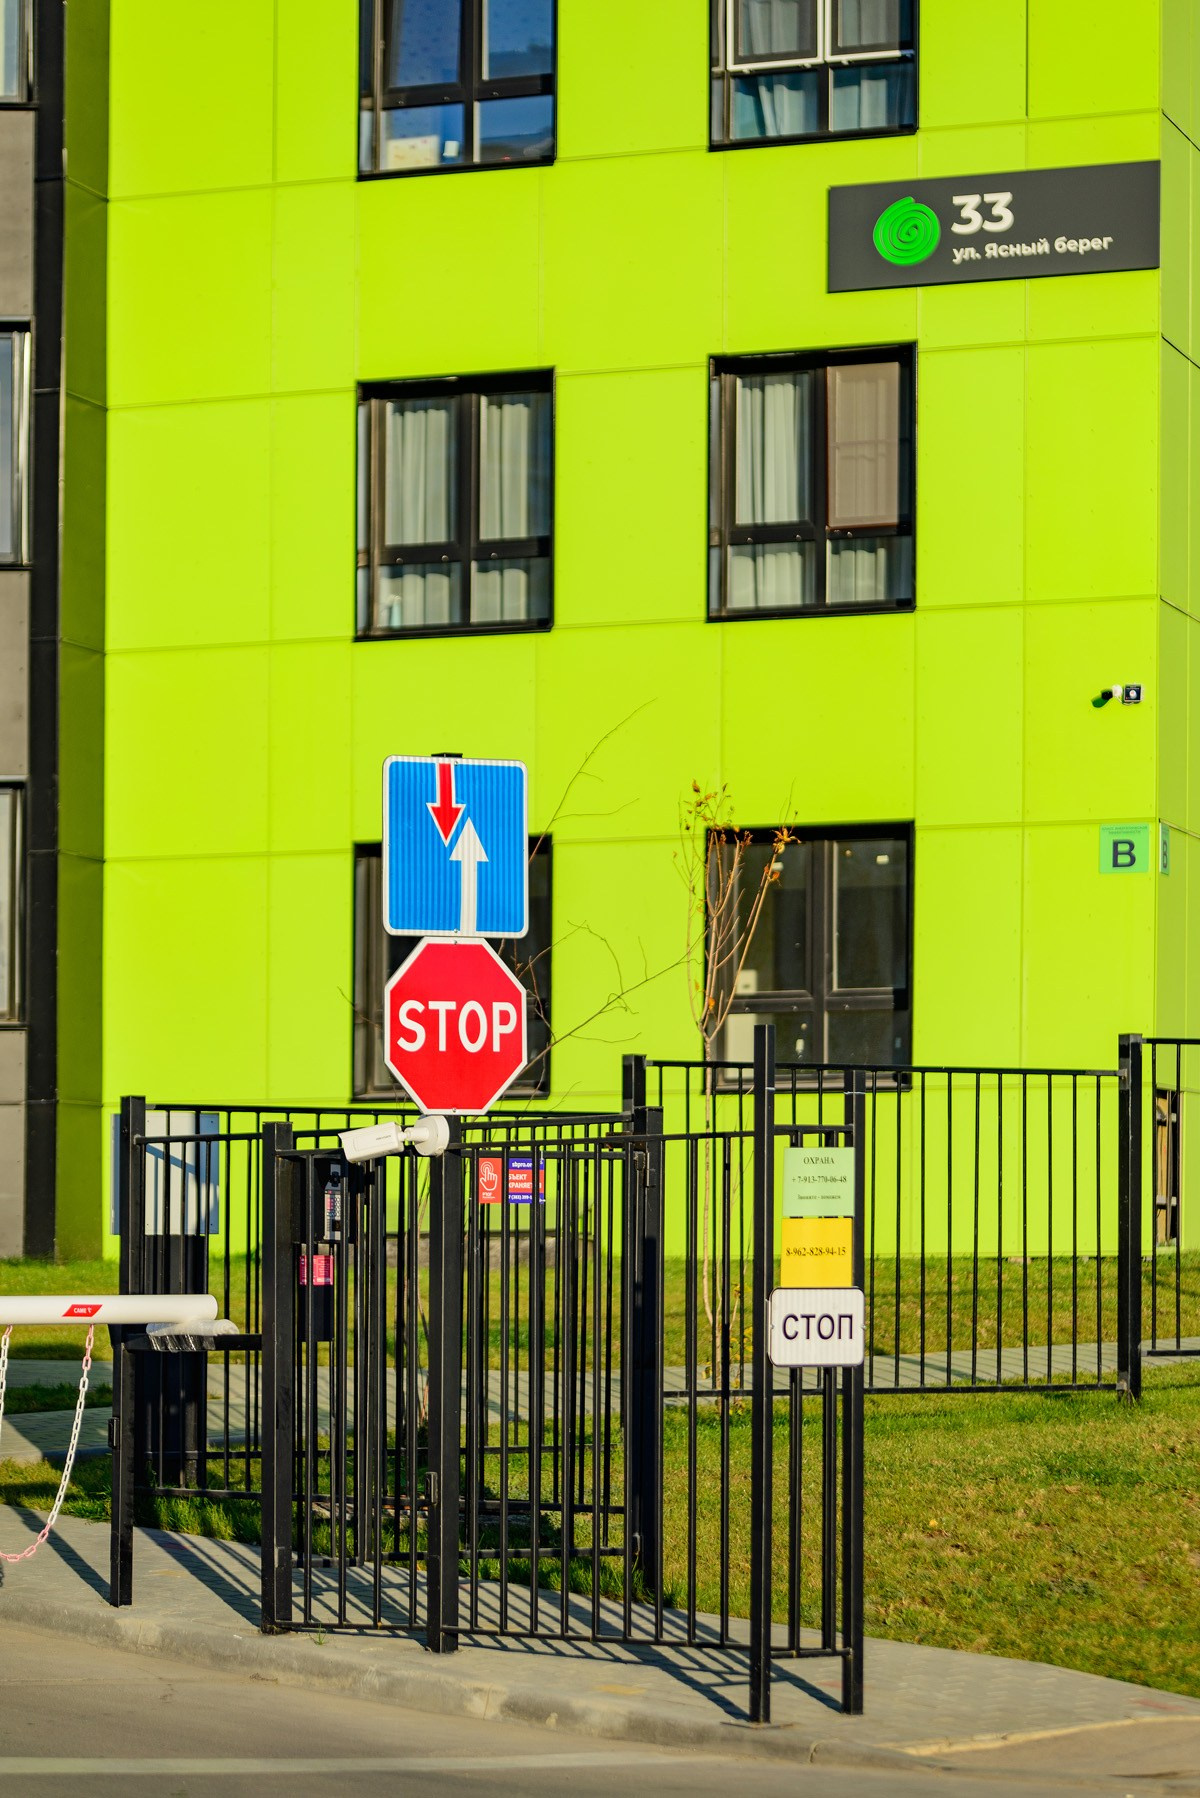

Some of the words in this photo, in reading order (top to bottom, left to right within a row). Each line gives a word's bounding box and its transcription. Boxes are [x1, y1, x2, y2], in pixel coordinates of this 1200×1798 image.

[950, 191, 1015, 235] 33
[952, 246, 981, 265] ул.
[984, 237, 1050, 259] Ясный
[1054, 235, 1115, 255] берег
[397, 999, 518, 1053] STOP
[803, 1156, 835, 1165] ОХРАНА
[785, 1246, 846, 1257] 8-962-828-94-15
[782, 1313, 853, 1340] СТОП
